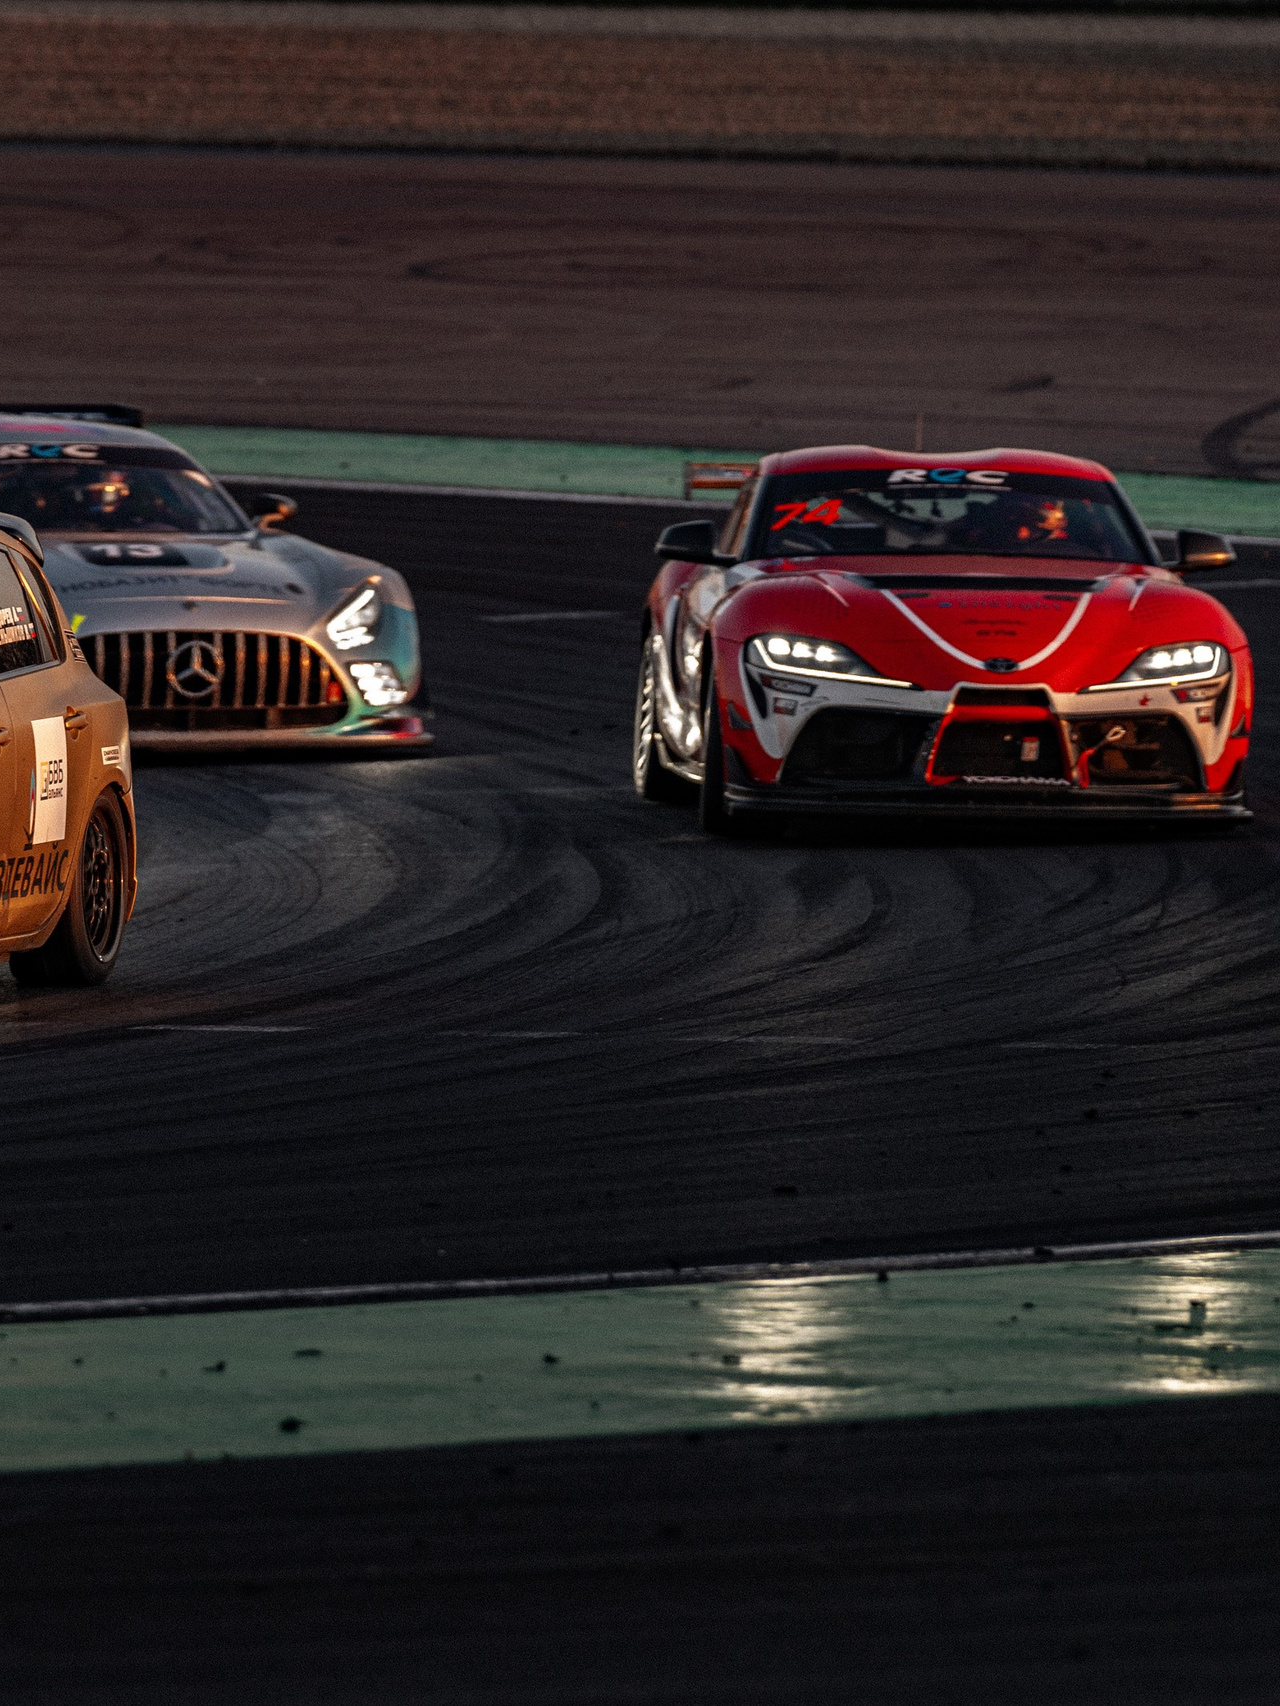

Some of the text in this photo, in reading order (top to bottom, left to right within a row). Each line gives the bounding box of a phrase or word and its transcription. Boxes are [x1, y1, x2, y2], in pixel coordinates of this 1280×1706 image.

[770, 499, 843, 530] 74
[92, 544, 164, 558] 13
[48, 759, 63, 786] БВБ
[961, 775, 1071, 786] YOKOHAMA
